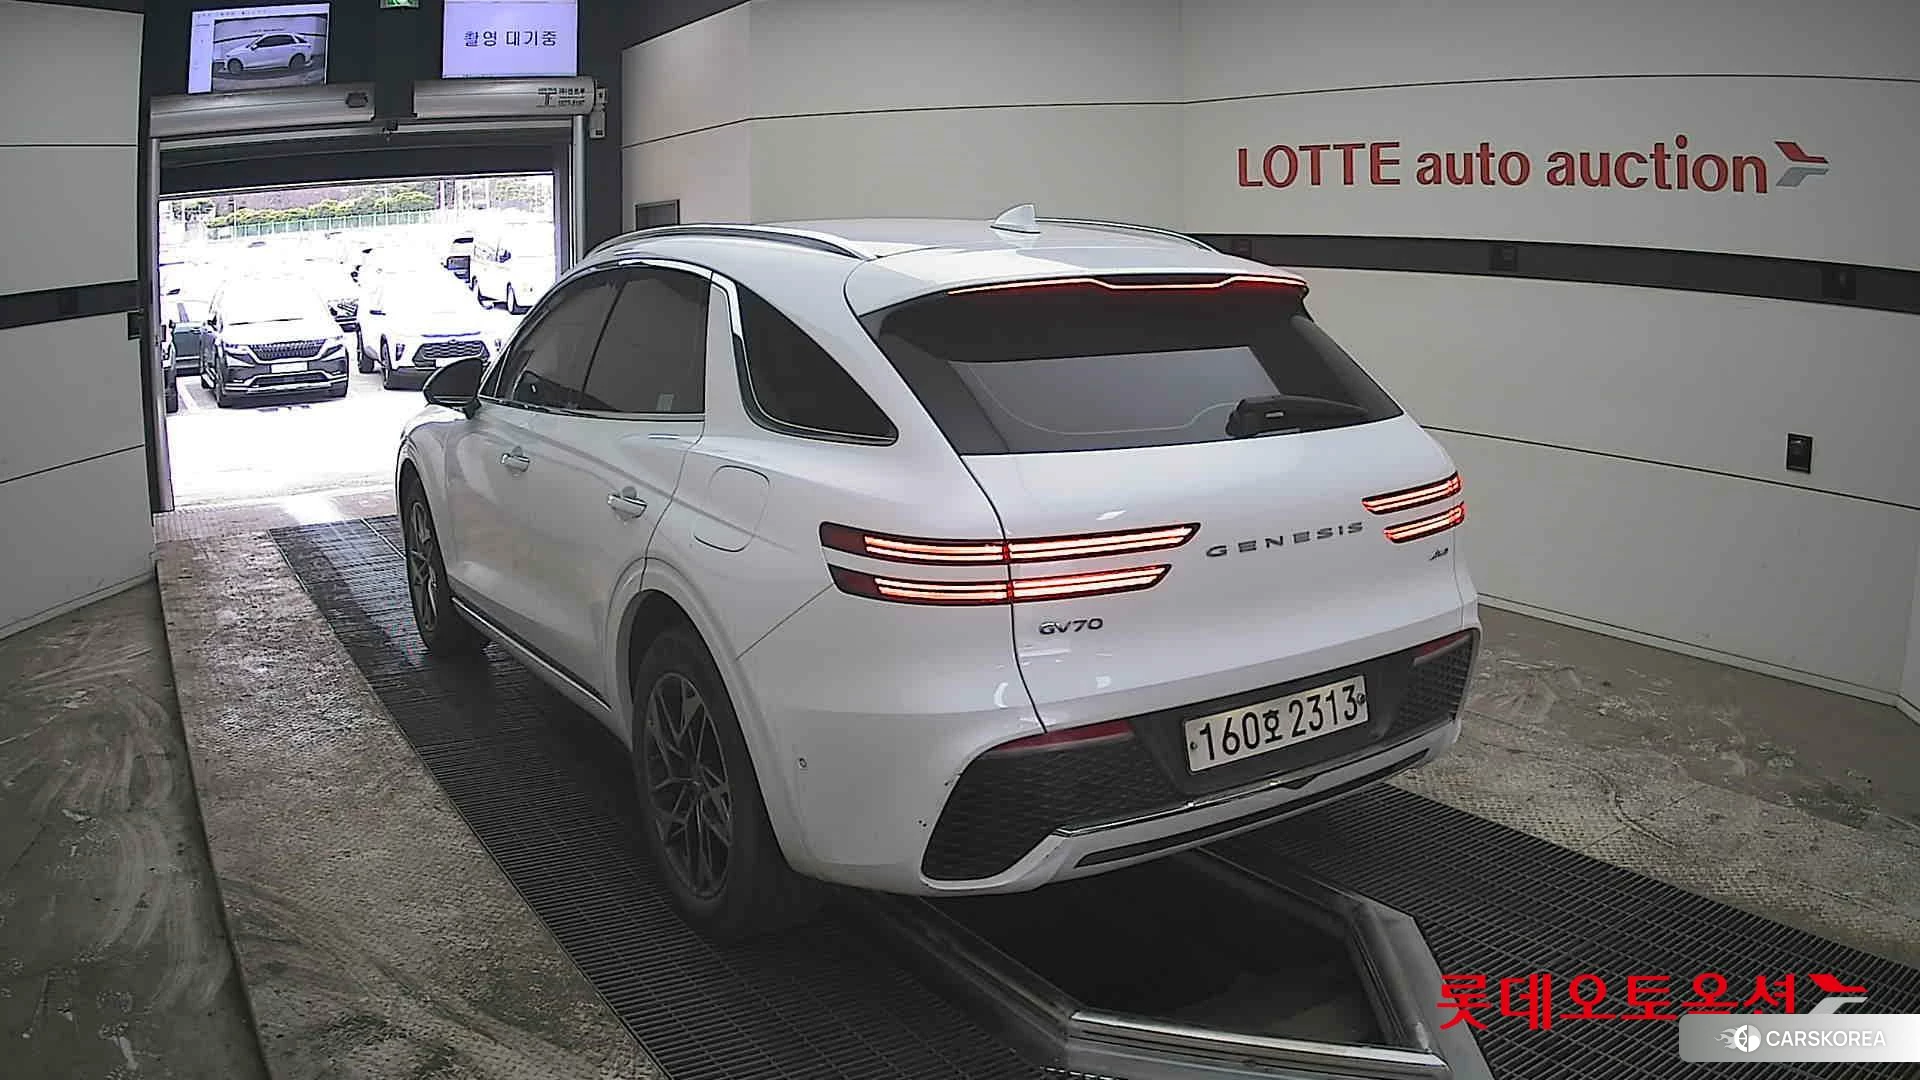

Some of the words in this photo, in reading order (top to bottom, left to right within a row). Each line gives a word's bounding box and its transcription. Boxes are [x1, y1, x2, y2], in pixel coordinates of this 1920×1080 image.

[464, 30, 497, 47] 촬영
[506, 30, 557, 47] 대기중
[1237, 141, 1400, 188] LOTTE
[1415, 142, 1531, 186] auto
[1545, 134, 1768, 194] auction
[1205, 521, 1364, 558] GENESIS
[1039, 617, 1104, 636] GV70
